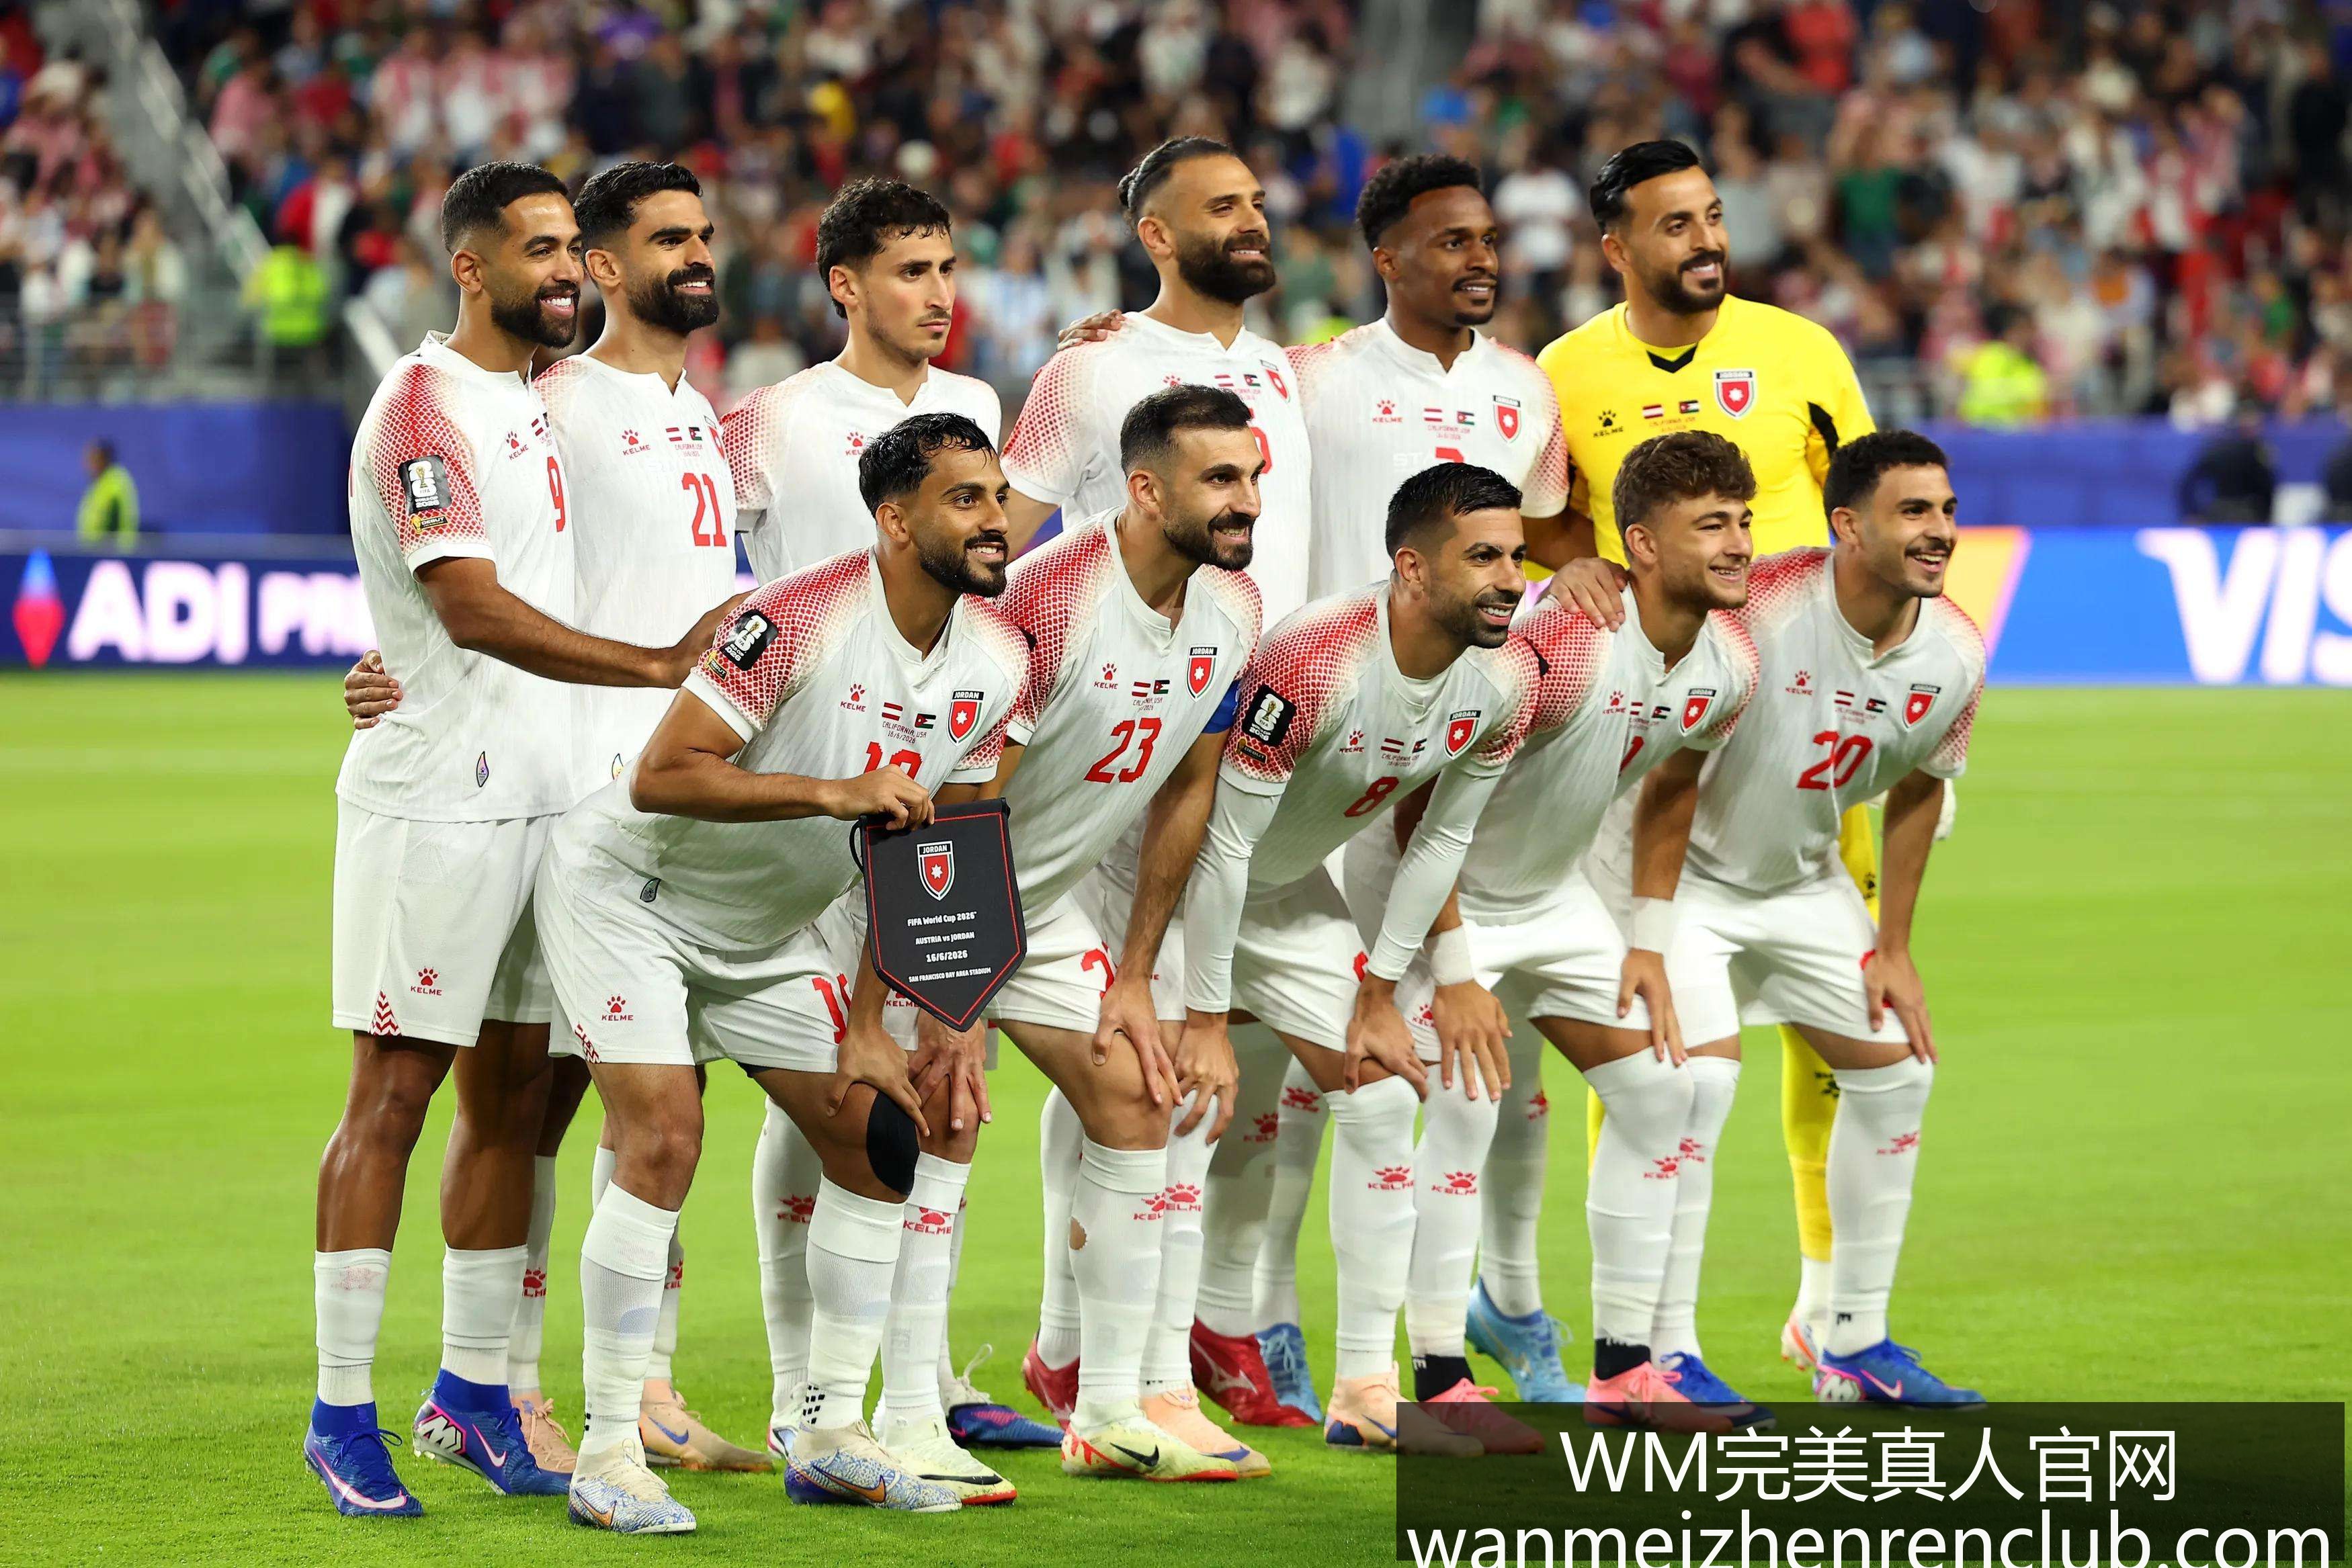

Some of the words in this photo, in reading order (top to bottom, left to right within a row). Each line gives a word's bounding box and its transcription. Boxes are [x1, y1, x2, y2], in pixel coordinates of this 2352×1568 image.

[509, 444, 529, 460] KELME
[623, 445, 650, 455] KELME
[547, 456, 566, 532] 9
[681, 472, 727, 547] 21
[421, 517, 445, 525] DEBUT
[68, 560, 249, 664] ADI
[1192, 647, 1214, 655] JORDAN
[1094, 681, 1118, 689] KELME
[1786, 687, 1812, 695] KELME
[954, 691, 979, 699] JORDAN
[840, 701, 866, 712] KELME
[1452, 711, 1477, 720] JORDAN
[888, 730, 916, 744] 16/6/2026
[1083, 717, 1163, 783] 23
[1796, 730, 1874, 791] 20
[1343, 777, 1400, 817] 8
[923, 844, 948, 854] JORDAN
[907, 918, 922, 926] FIFA
[923, 914, 943, 924] World
[943, 914, 956, 923] Cup
[915, 935, 941, 945] AUSTRIA
[951, 931, 974, 942] JORDAN
[926, 950, 968, 962] 16/6/2026
[919, 972, 945, 982] FRANCISCO
[956, 969, 969, 977] AREA
[970, 967, 991, 975] STADIUM
[411, 986, 442, 996] KELME
[903, 1219, 952, 1235] KELME
